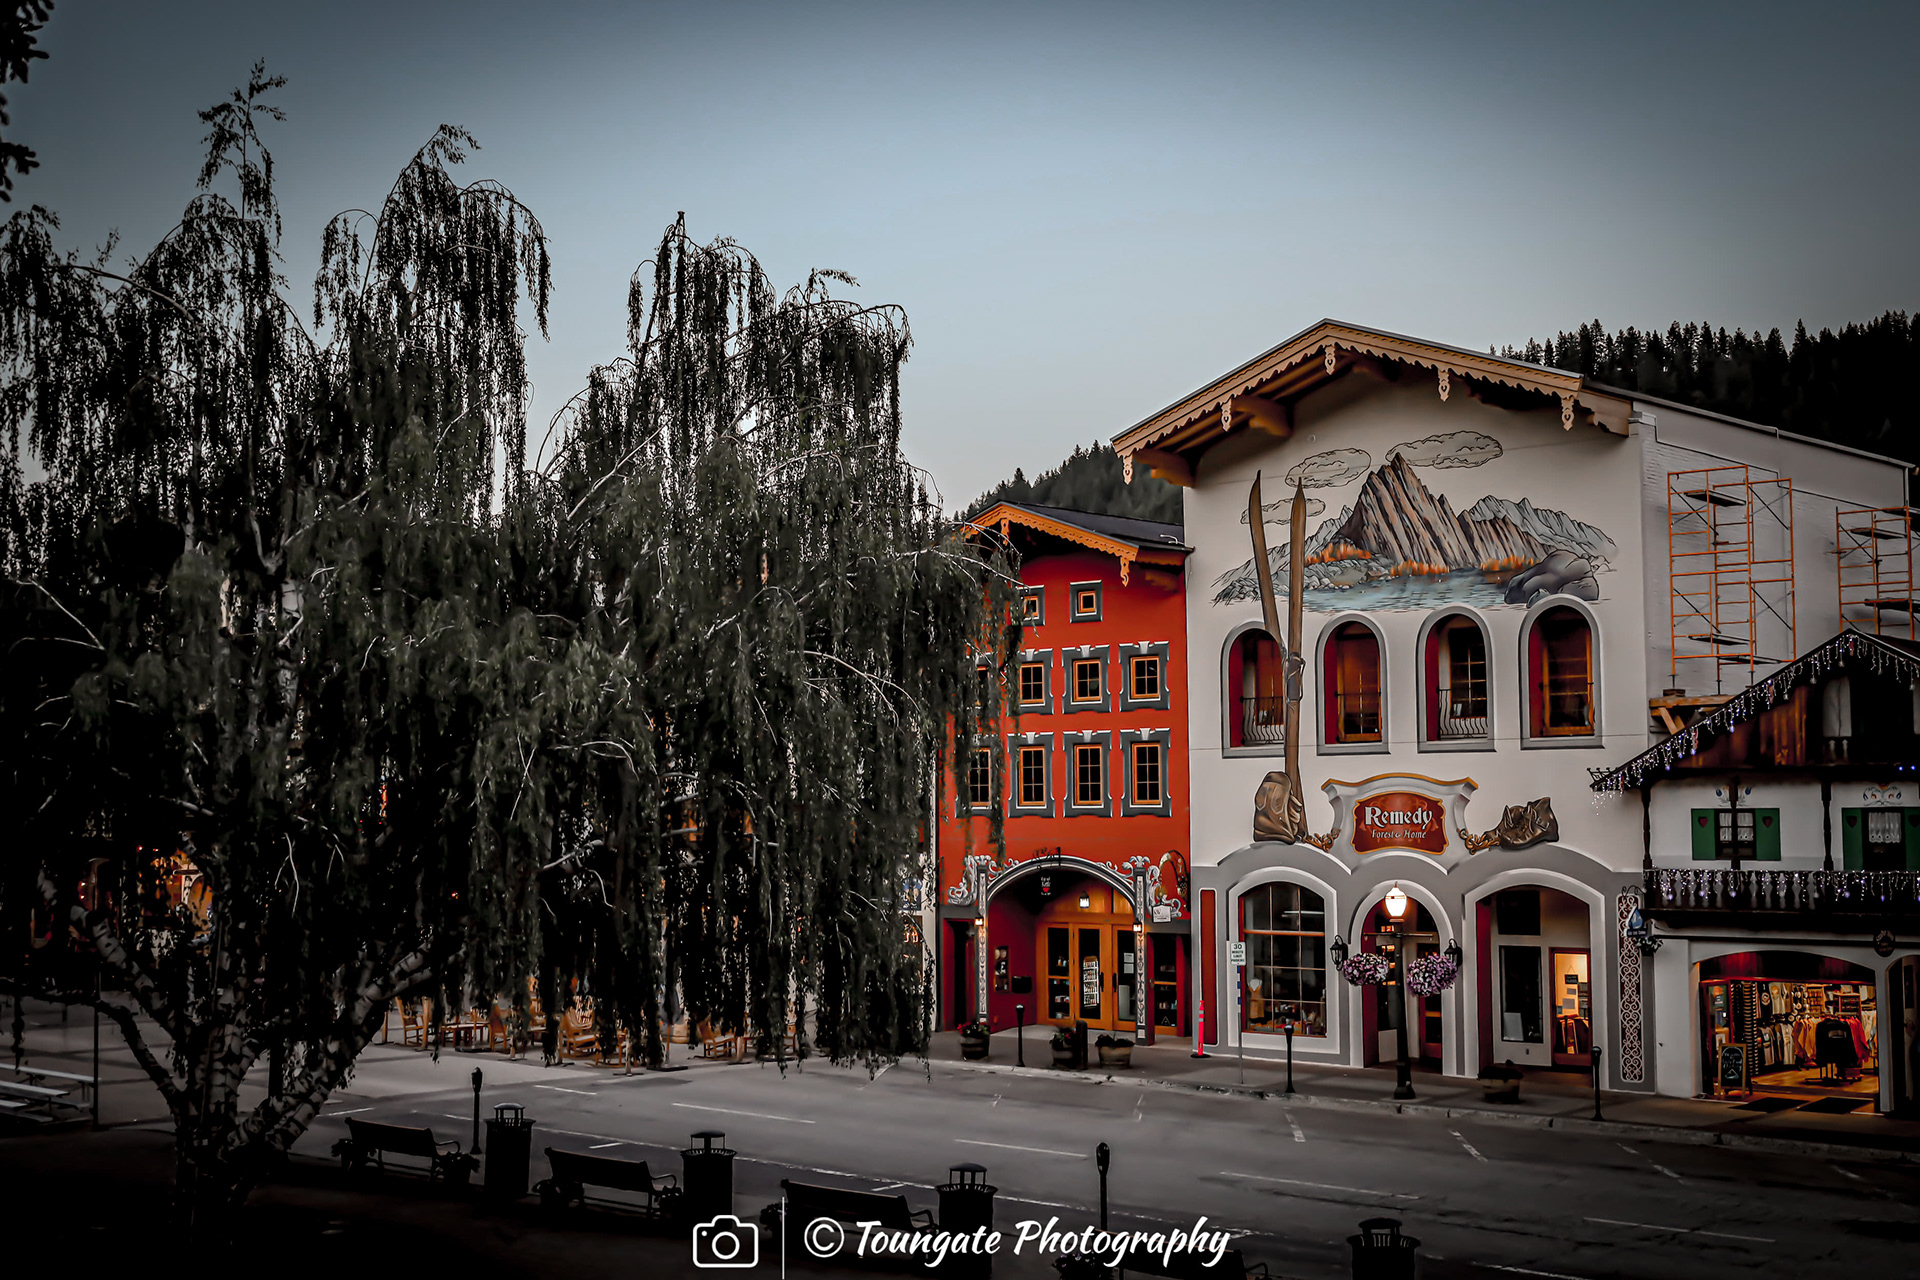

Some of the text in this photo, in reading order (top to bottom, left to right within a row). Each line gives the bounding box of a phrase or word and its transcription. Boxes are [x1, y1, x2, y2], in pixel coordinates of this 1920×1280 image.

[1365, 806, 1433, 830] Remedy
[1372, 829, 1394, 838] Forest
[1403, 829, 1427, 838] Home
